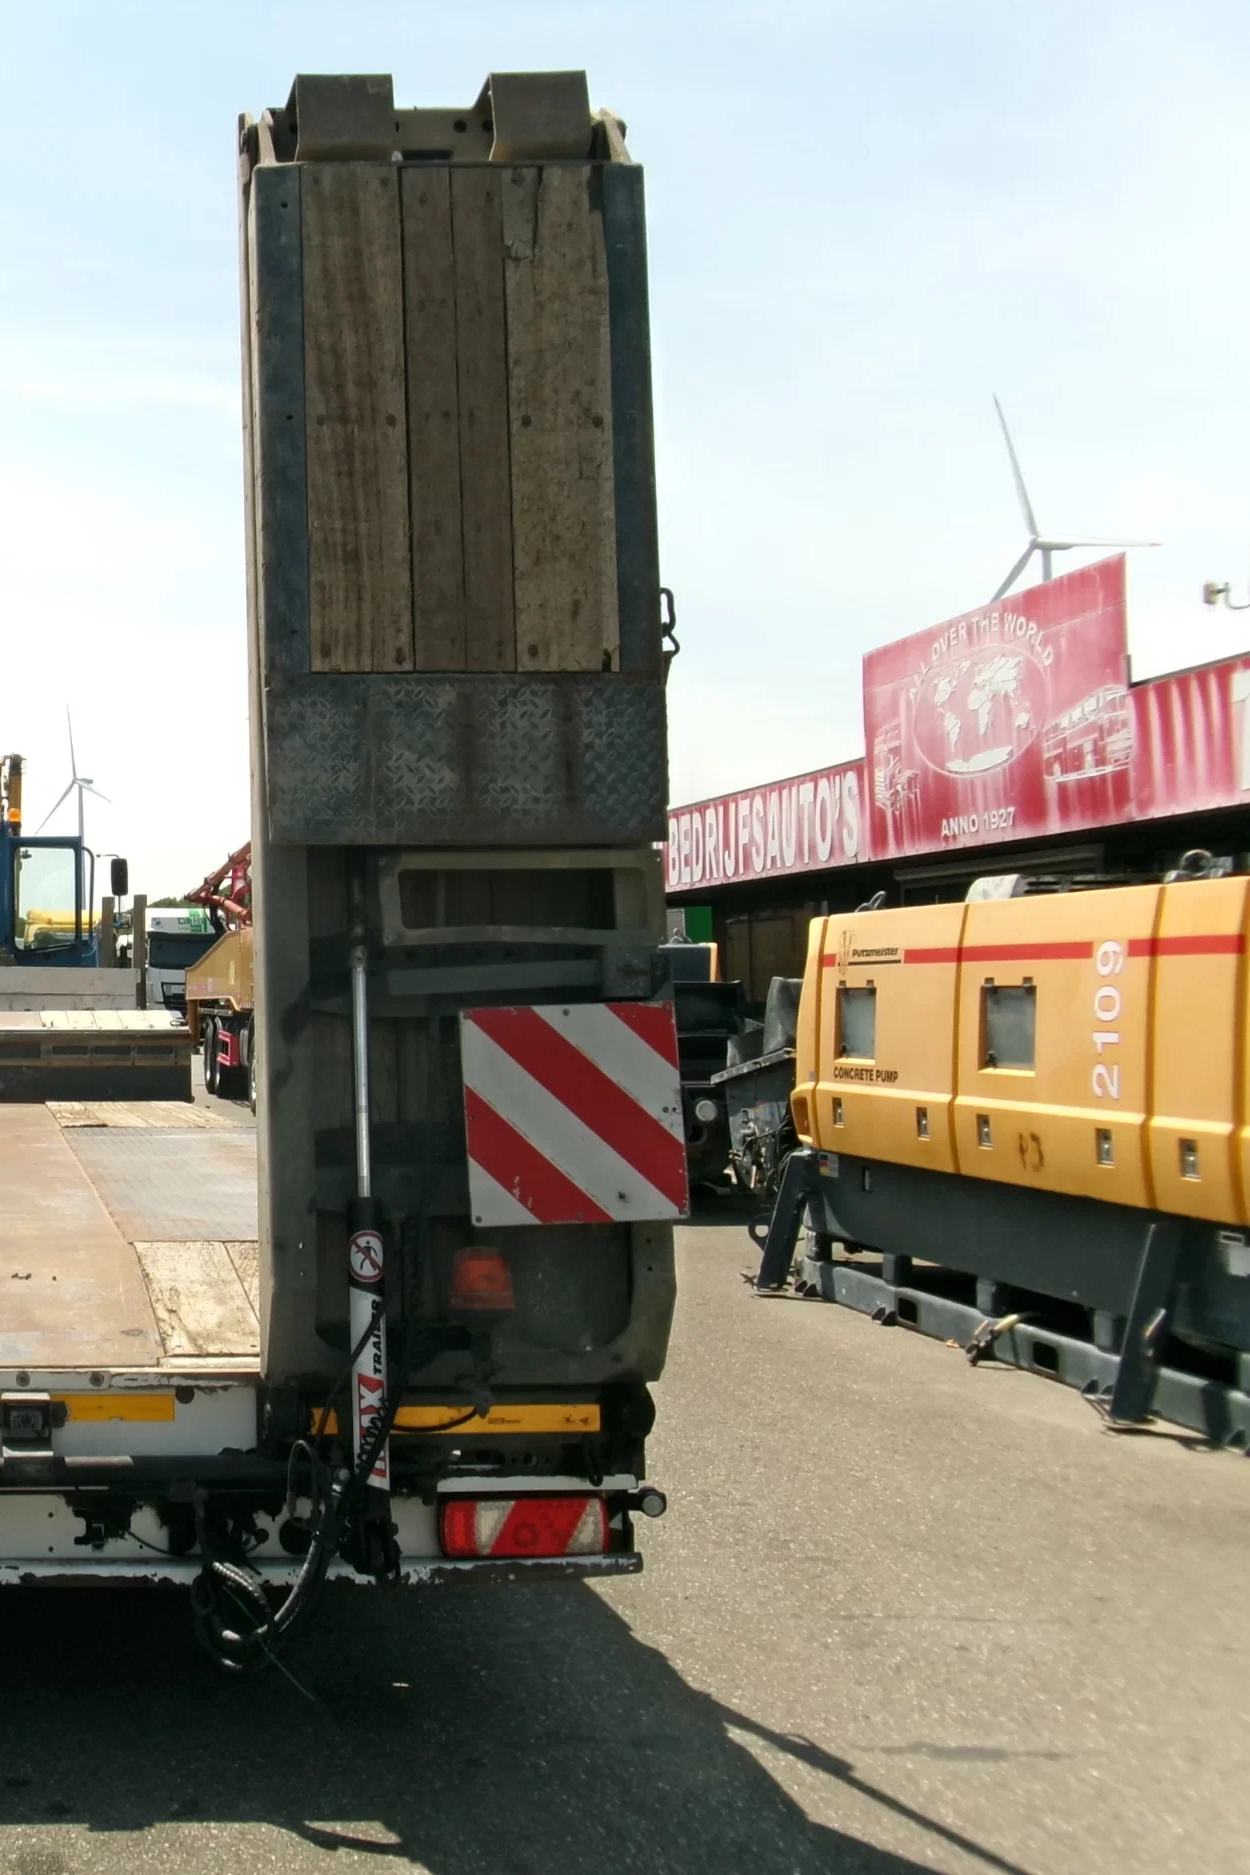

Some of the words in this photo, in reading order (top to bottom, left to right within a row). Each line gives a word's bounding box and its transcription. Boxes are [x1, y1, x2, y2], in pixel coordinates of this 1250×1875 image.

[932, 622, 968, 661] OVER
[971, 612, 999, 635] THE
[1004, 612, 1054, 666] WORLD
[668, 770, 859, 887] BEDRIJFSAUTO'S
[941, 814, 979, 837] ANNO
[983, 806, 1015, 830] 1927
[852, 947, 899, 958] Putzmeister
[1092, 940, 1123, 1100] 2109
[833, 1066, 875, 1082] CONCRETE
[875, 1069, 899, 1084] PUMP
